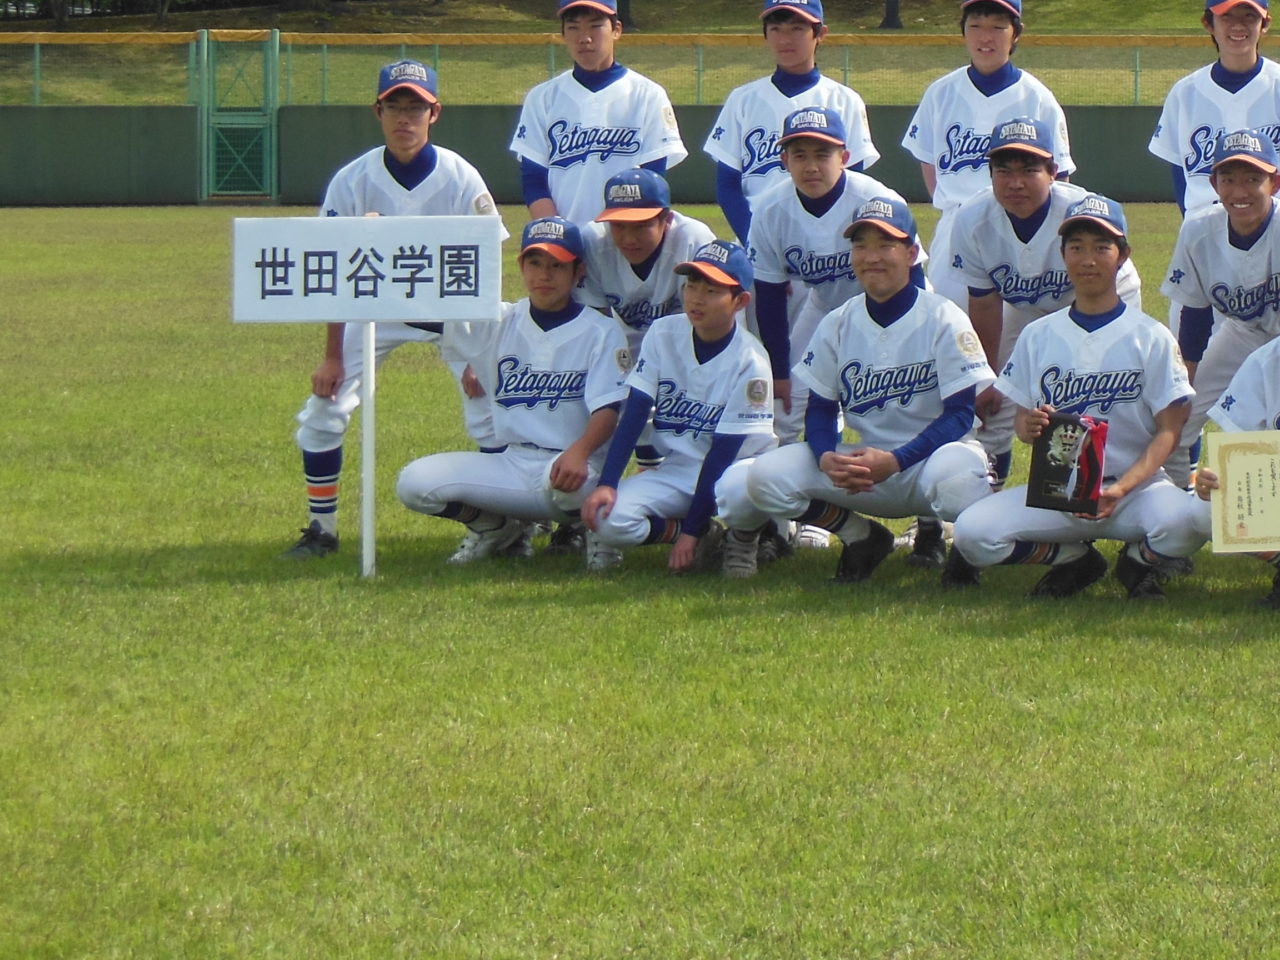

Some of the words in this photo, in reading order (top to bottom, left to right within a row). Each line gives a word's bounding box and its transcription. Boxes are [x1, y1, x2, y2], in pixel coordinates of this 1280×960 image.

[548, 119, 641, 169] Setagaya
[742, 126, 786, 177] Seta
[939, 122, 992, 175] Setag
[254, 244, 480, 300] 世田谷学園
[784, 245, 857, 285] Setaga
[495, 354, 589, 410] Setagaya
[839, 359, 939, 417] Setagaya
[1037, 365, 1144, 415] Setagaya
